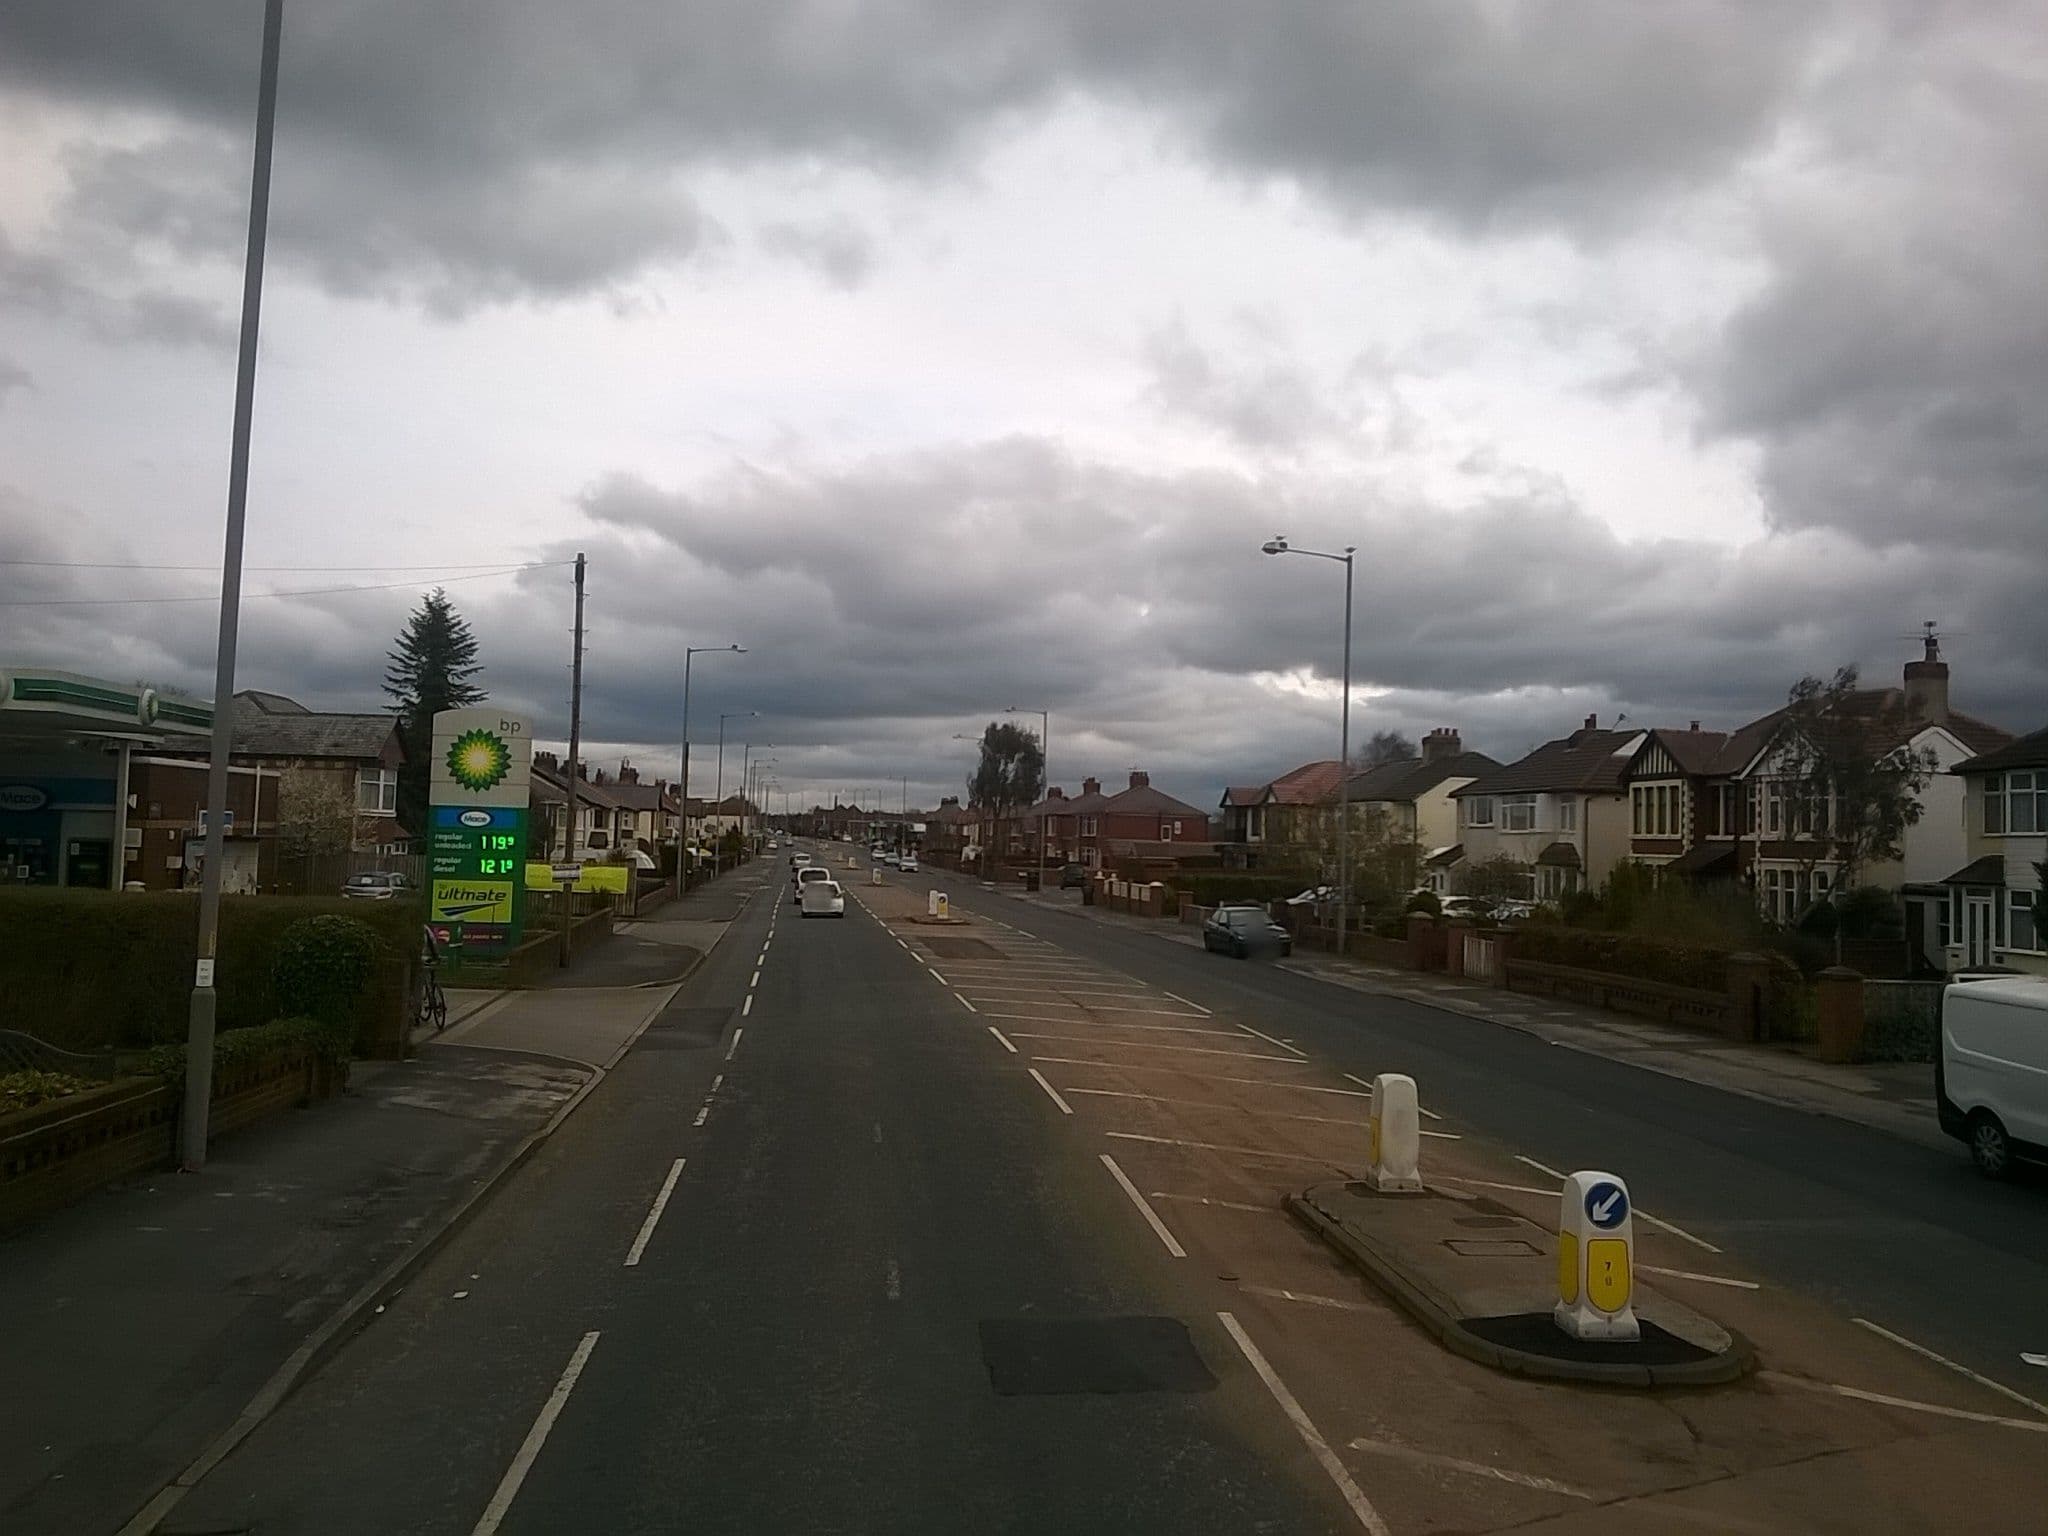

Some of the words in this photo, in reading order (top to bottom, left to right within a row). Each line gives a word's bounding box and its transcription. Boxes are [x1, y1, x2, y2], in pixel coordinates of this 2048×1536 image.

[500, 718, 521, 735] bp
[462, 815, 488, 823] Mace
[434, 833, 464, 841] regular
[434, 842, 472, 850] unleaded
[433, 857, 462, 865] regular
[433, 865, 456, 873] diesel
